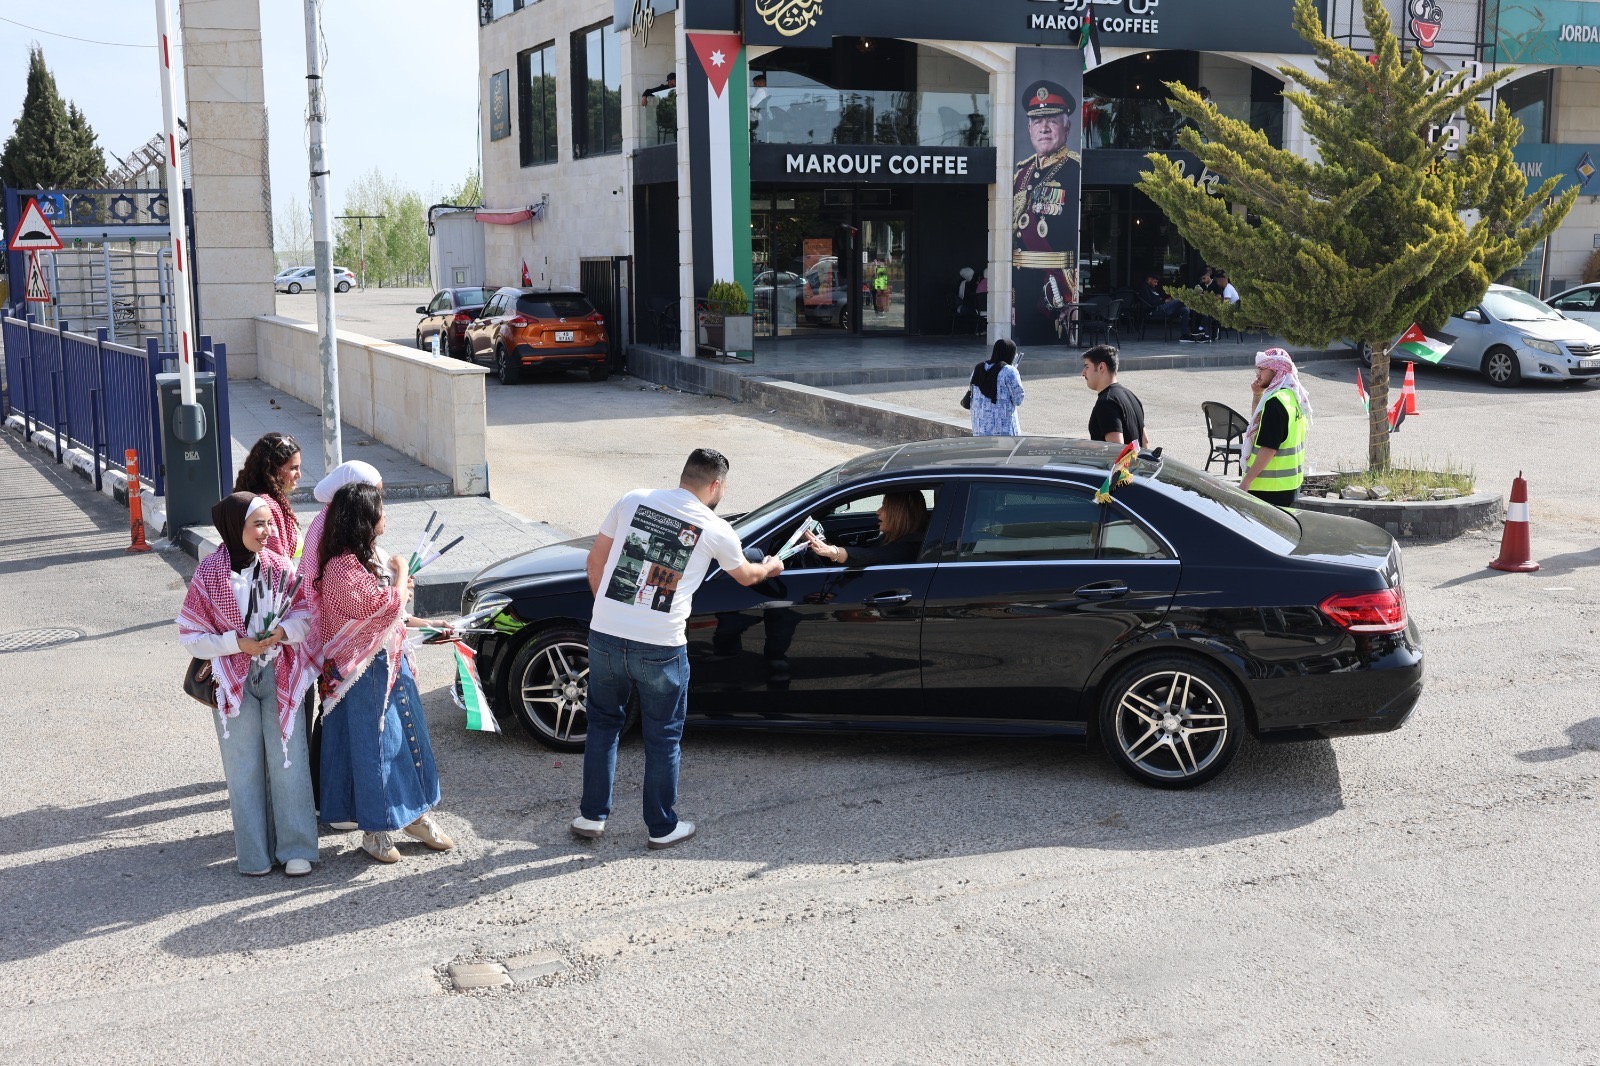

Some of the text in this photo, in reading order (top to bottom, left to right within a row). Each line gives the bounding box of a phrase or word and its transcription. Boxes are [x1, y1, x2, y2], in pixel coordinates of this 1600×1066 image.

[1031, 14, 1159, 34] MARO COFFEE
[1559, 24, 1600, 42] JORDA
[786, 153, 968, 175] MAROUF COFFEE
[1513, 161, 1543, 177] ANK
[184, 450, 201, 461] DEA
